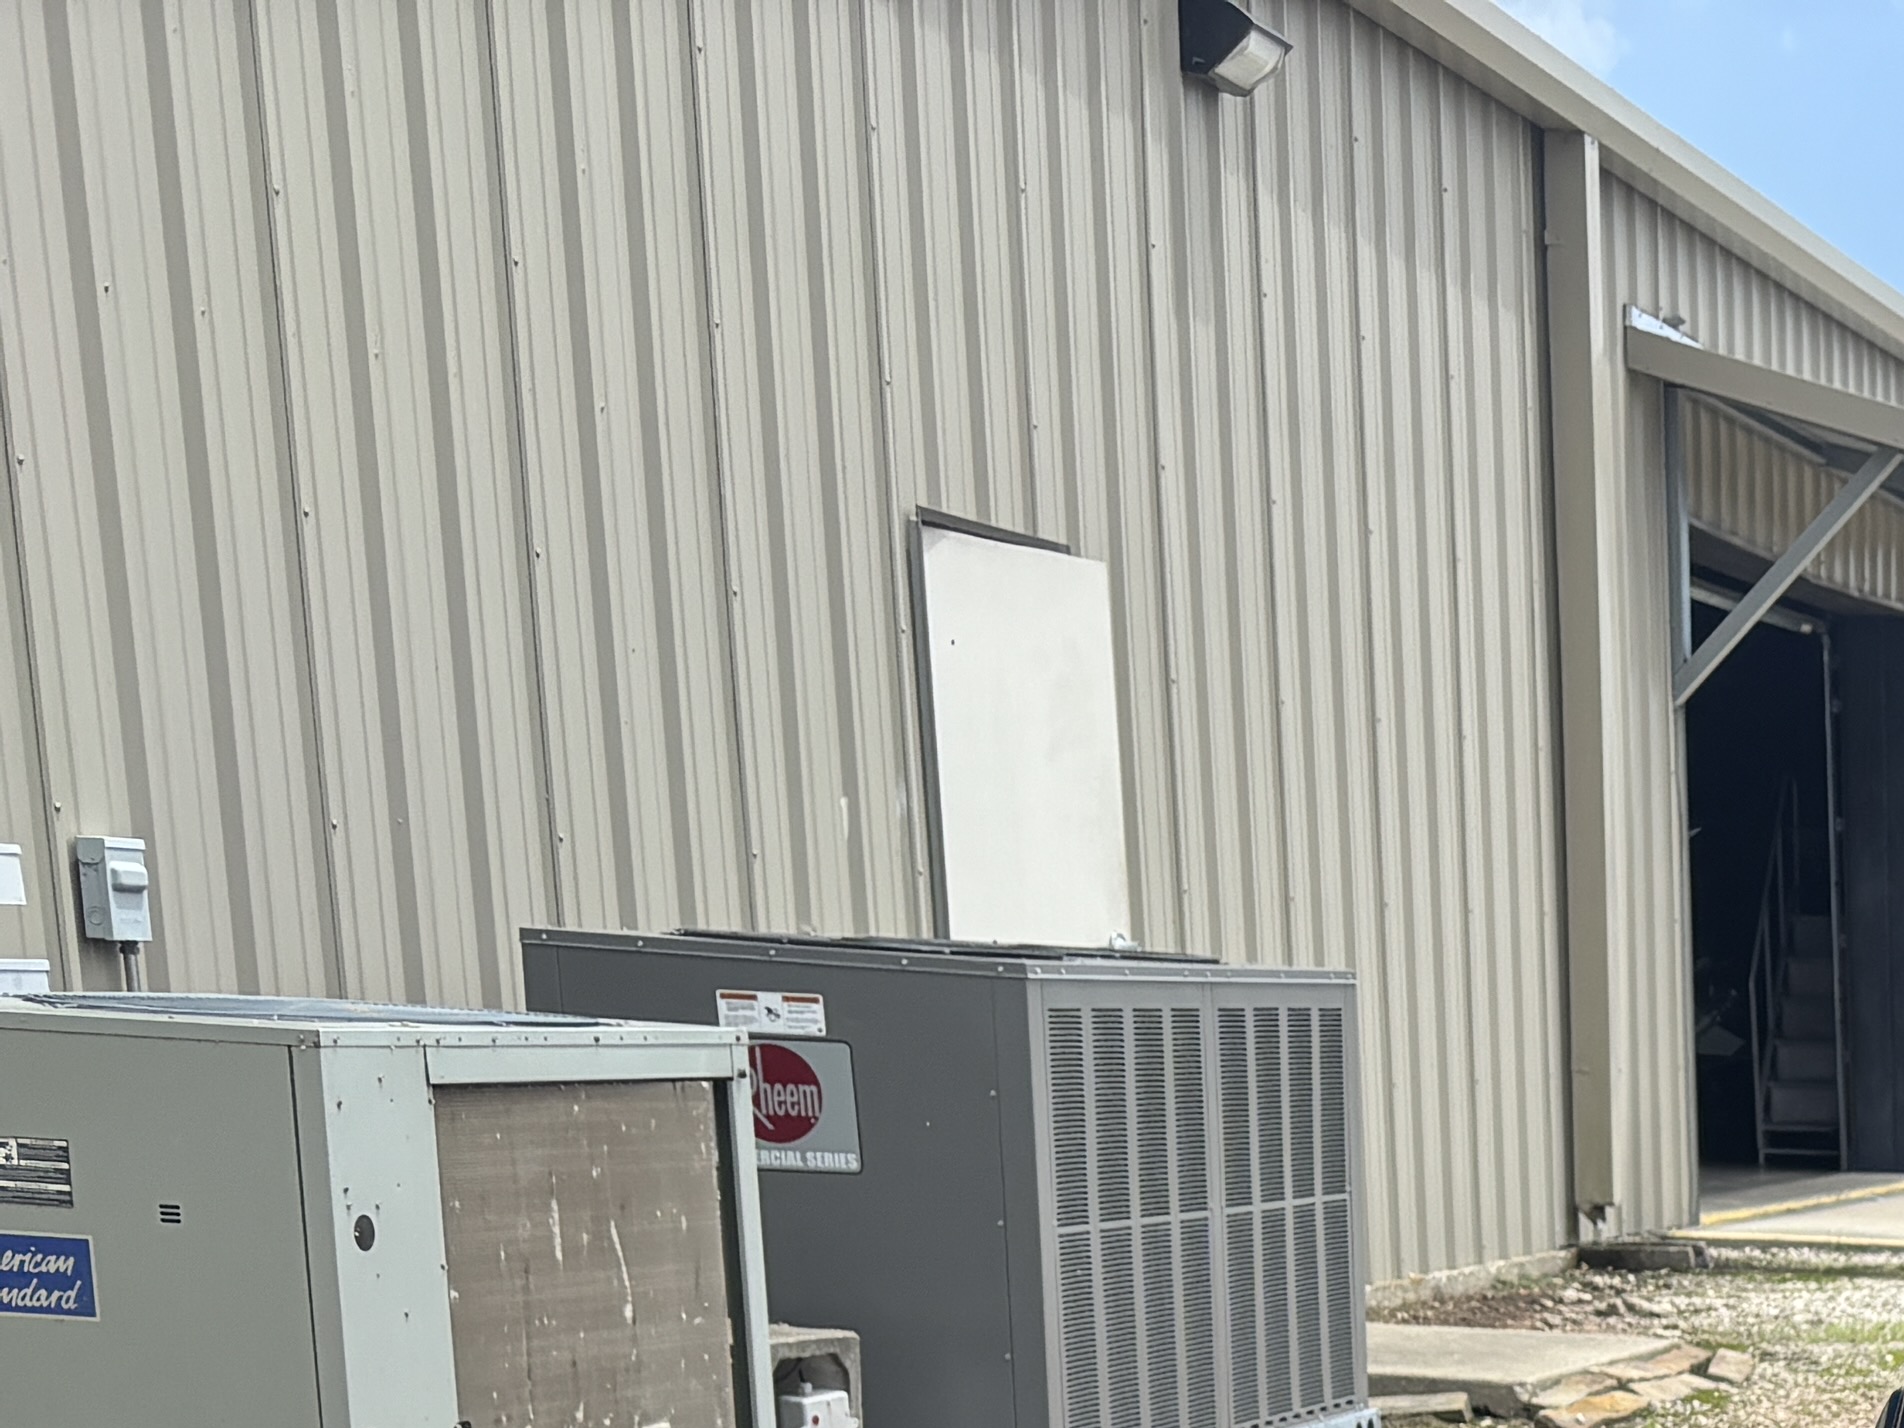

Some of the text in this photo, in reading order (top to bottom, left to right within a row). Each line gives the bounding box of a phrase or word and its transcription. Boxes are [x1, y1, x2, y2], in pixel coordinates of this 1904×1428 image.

[757, 1149, 858, 1169] RCIAL SERIES
[0, 1246, 75, 1276] erican
[0, 1278, 82, 1310] ndard
